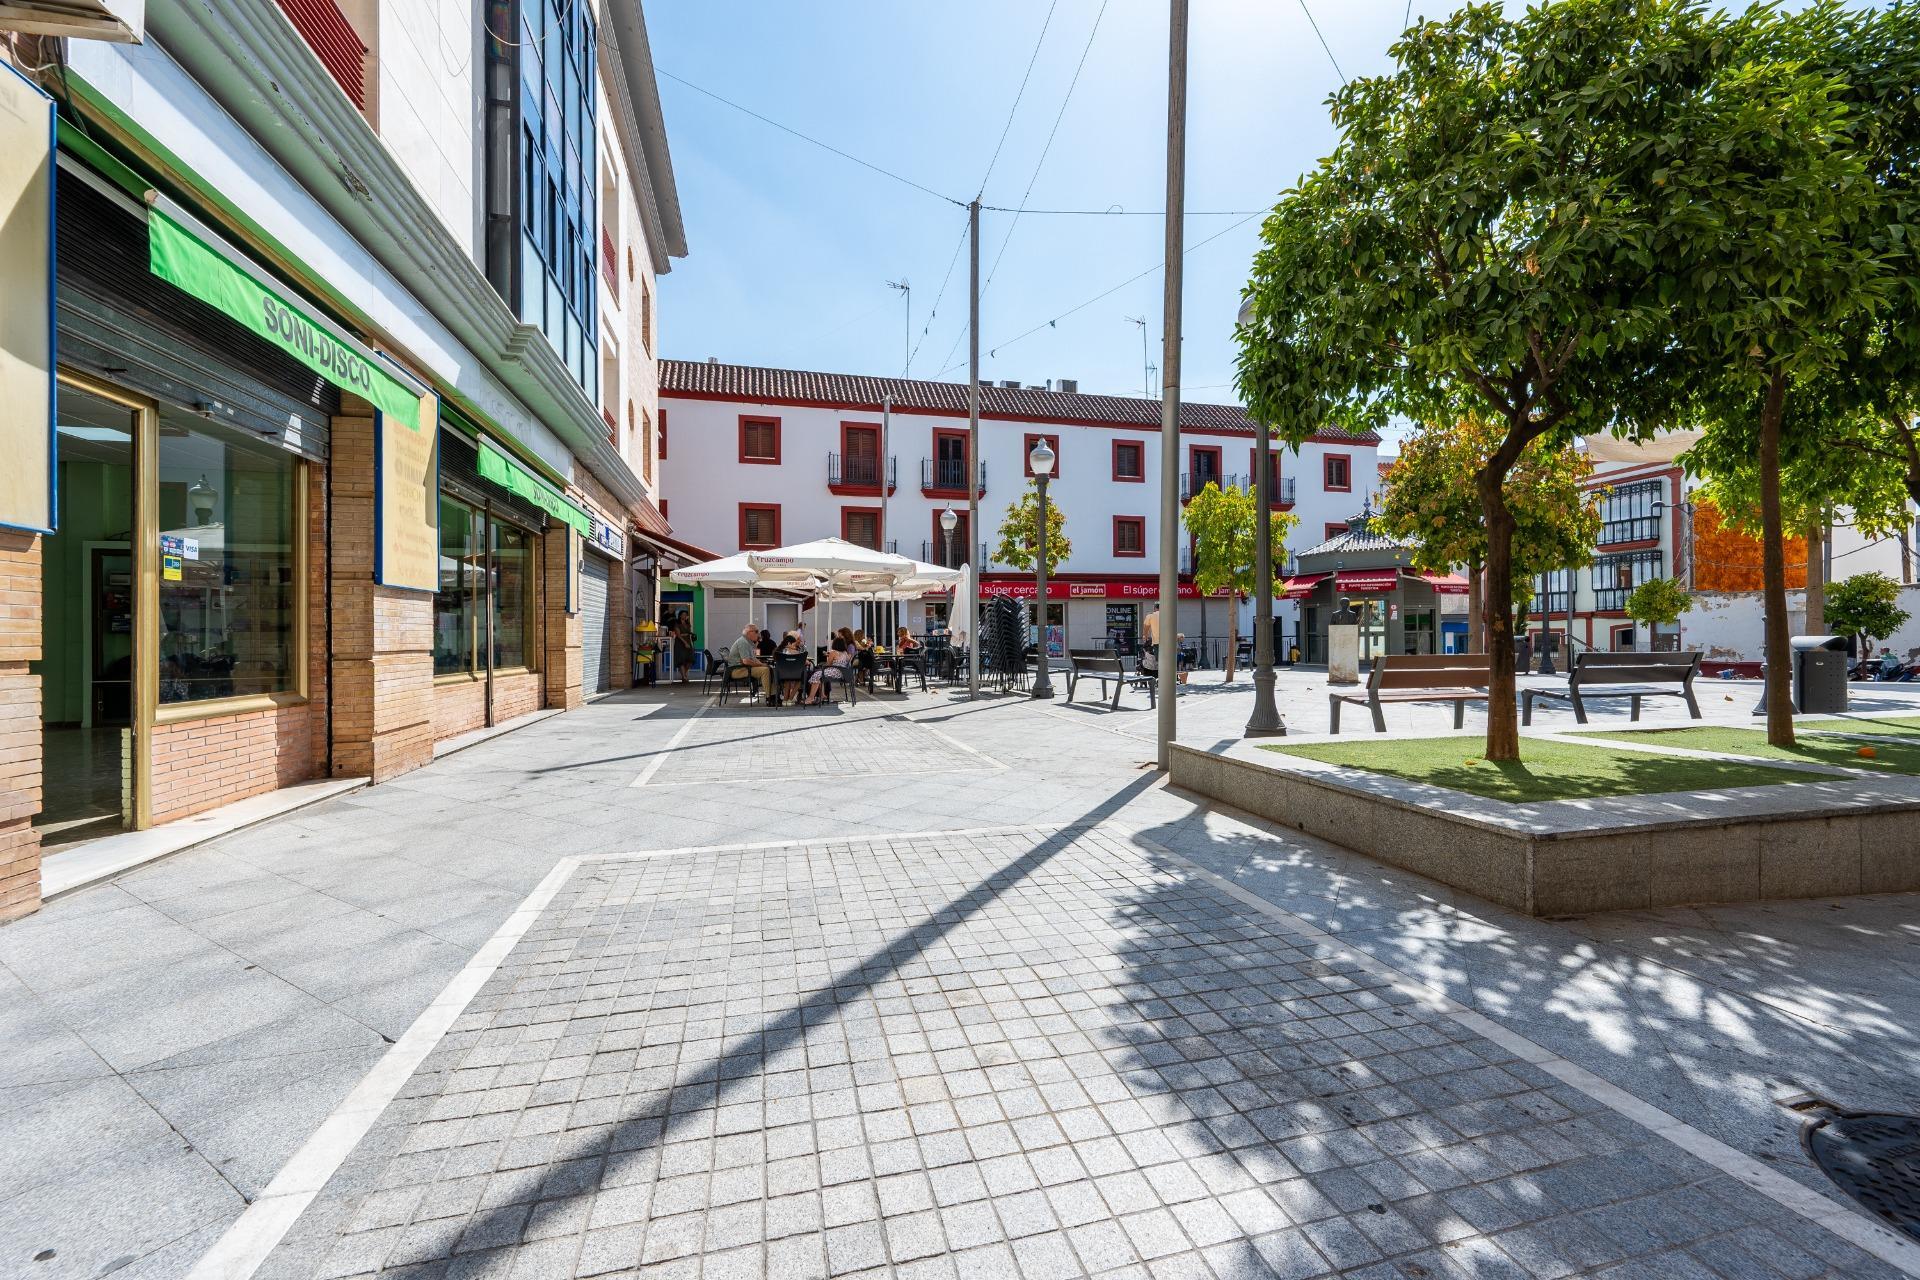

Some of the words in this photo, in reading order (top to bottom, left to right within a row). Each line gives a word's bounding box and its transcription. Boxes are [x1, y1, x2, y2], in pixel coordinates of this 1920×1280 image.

[263, 297, 370, 392] SONI-DISCO
[984, 584, 1012, 596] súper
[1013, 586, 1053, 594] cercao
[1072, 586, 1079, 594] el
[1080, 586, 1104, 595] jamón
[1123, 585, 1132, 594] El
[1132, 585, 1158, 596] súper
